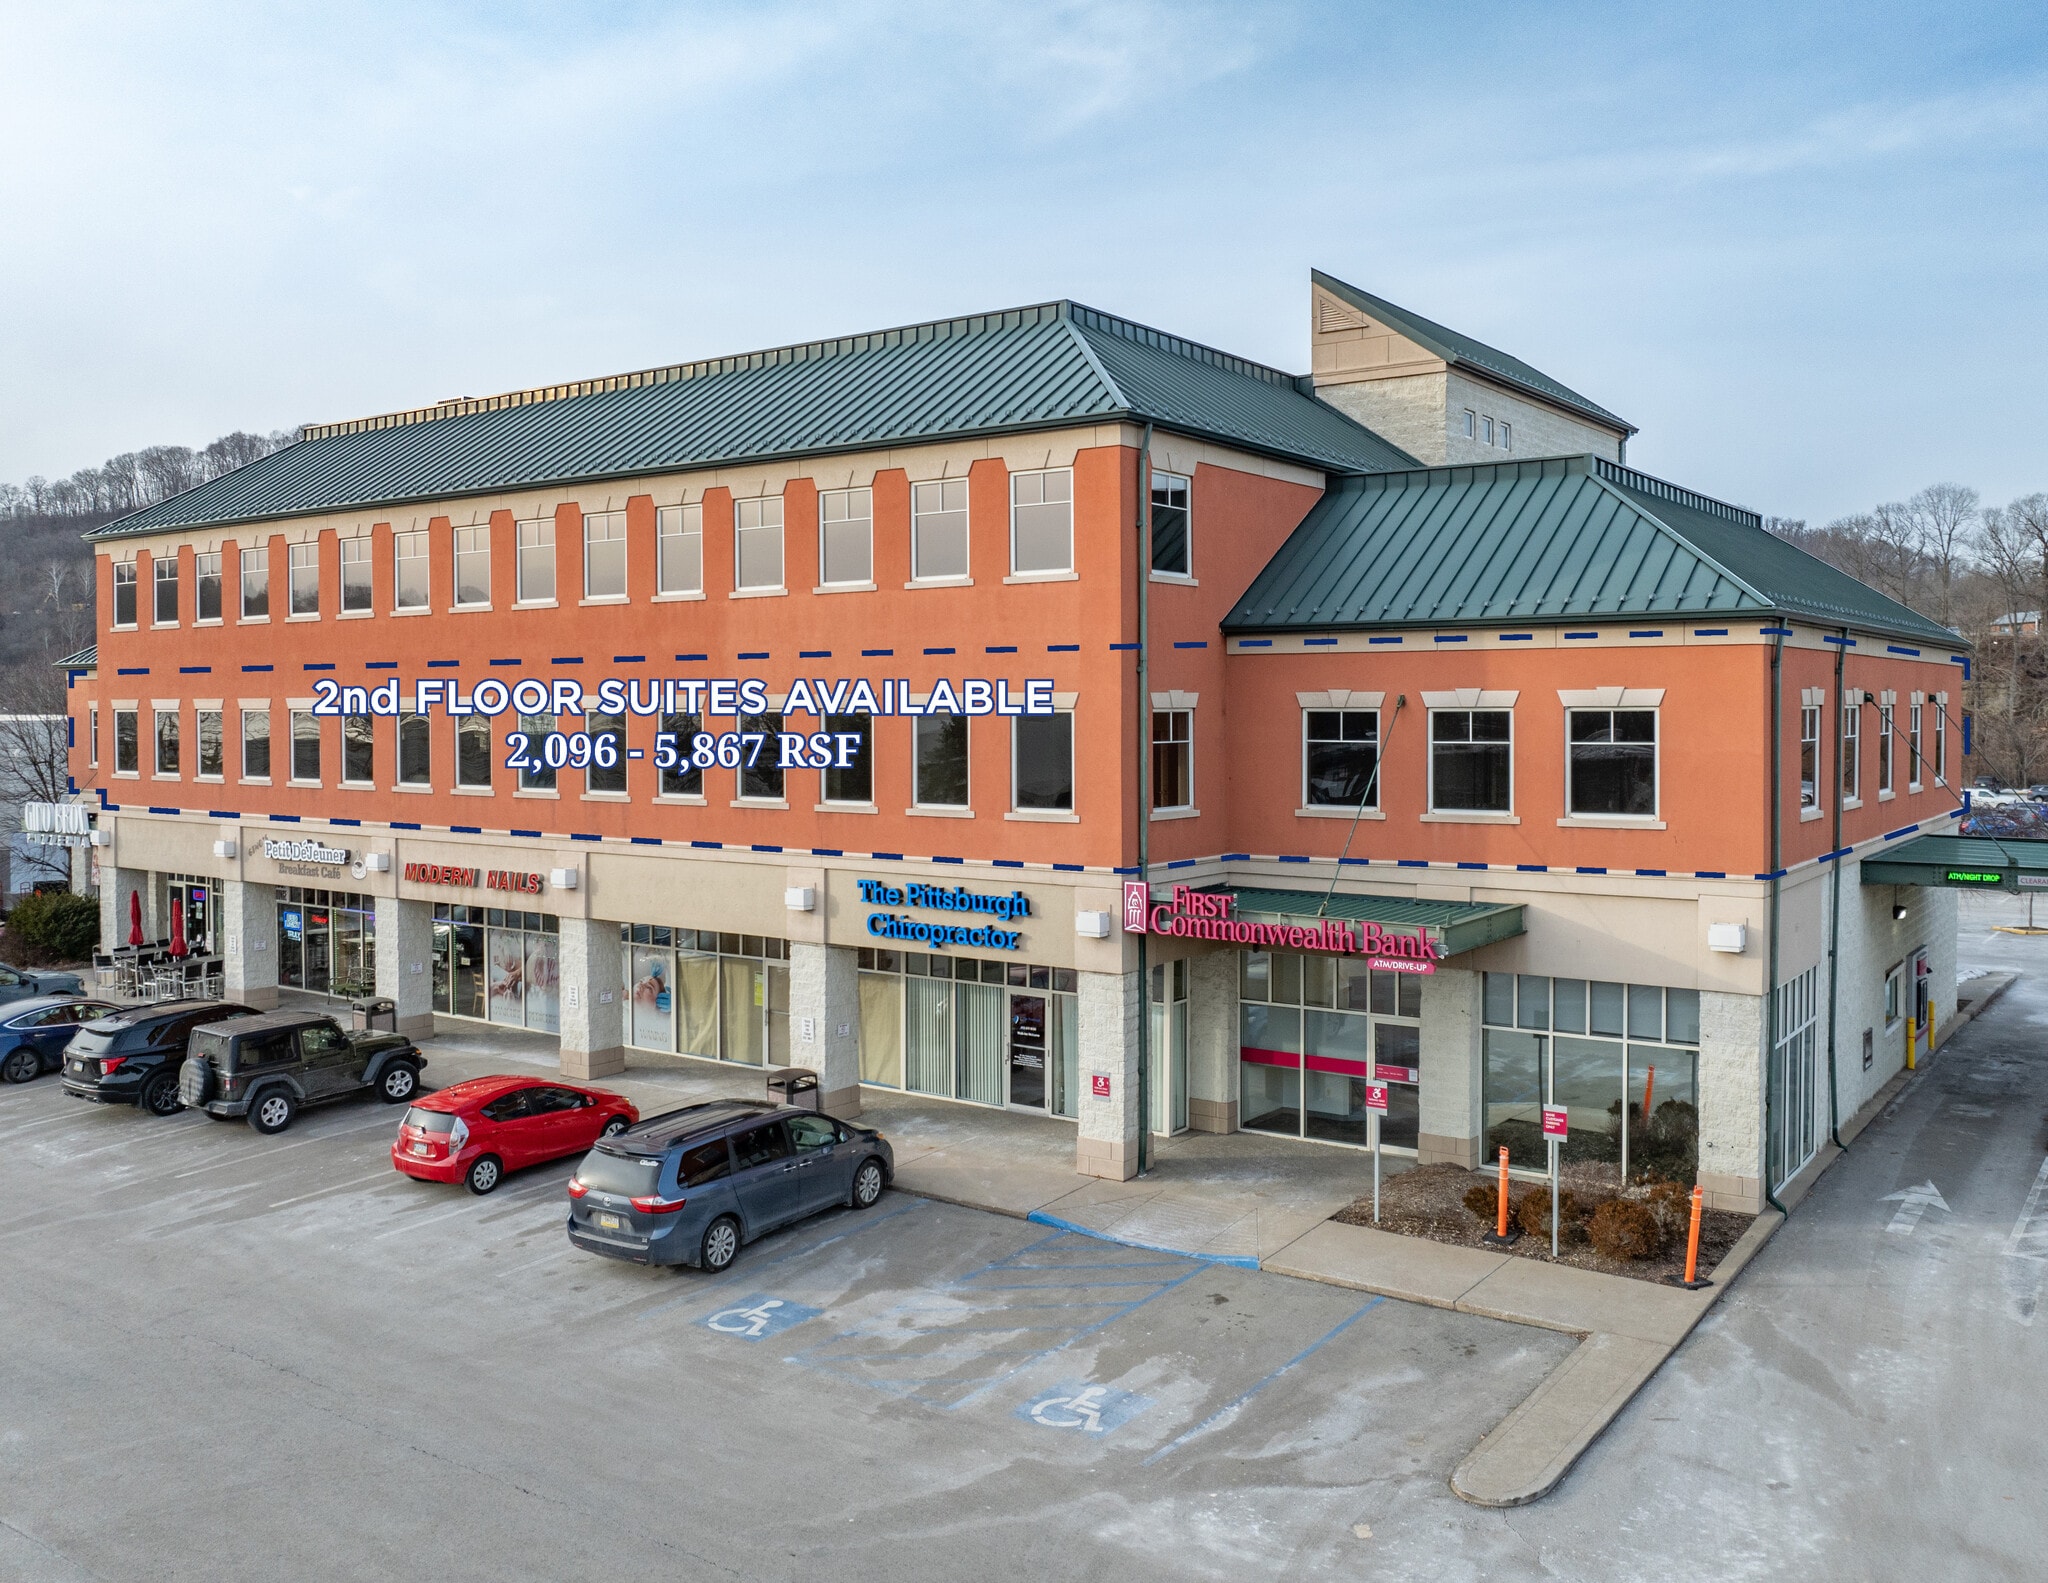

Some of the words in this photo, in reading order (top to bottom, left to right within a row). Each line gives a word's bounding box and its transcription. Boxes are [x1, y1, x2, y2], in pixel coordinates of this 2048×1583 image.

[27, 833, 90, 848] PIZZERIA
[264, 840, 291, 860] Petit
[279, 862, 319, 877] Breakfast
[321, 867, 341, 879] Café
[404, 863, 475, 888] MODERN
[487, 870, 540, 894] NAILS
[1983, 874, 2000, 882] DROP
[2020, 877, 2048, 885] CLEARA
[857, 879, 901, 905] The
[906, 883, 1028, 922] Pittsburgh
[1172, 885, 1233, 918] FIRST
[867, 913, 1018, 949] Chiropractor
[1151, 904, 1356, 953] Commonwealth
[1361, 921, 1439, 960] Bank
[1373, 959, 1428, 972] ATM/DRIVE-UP
